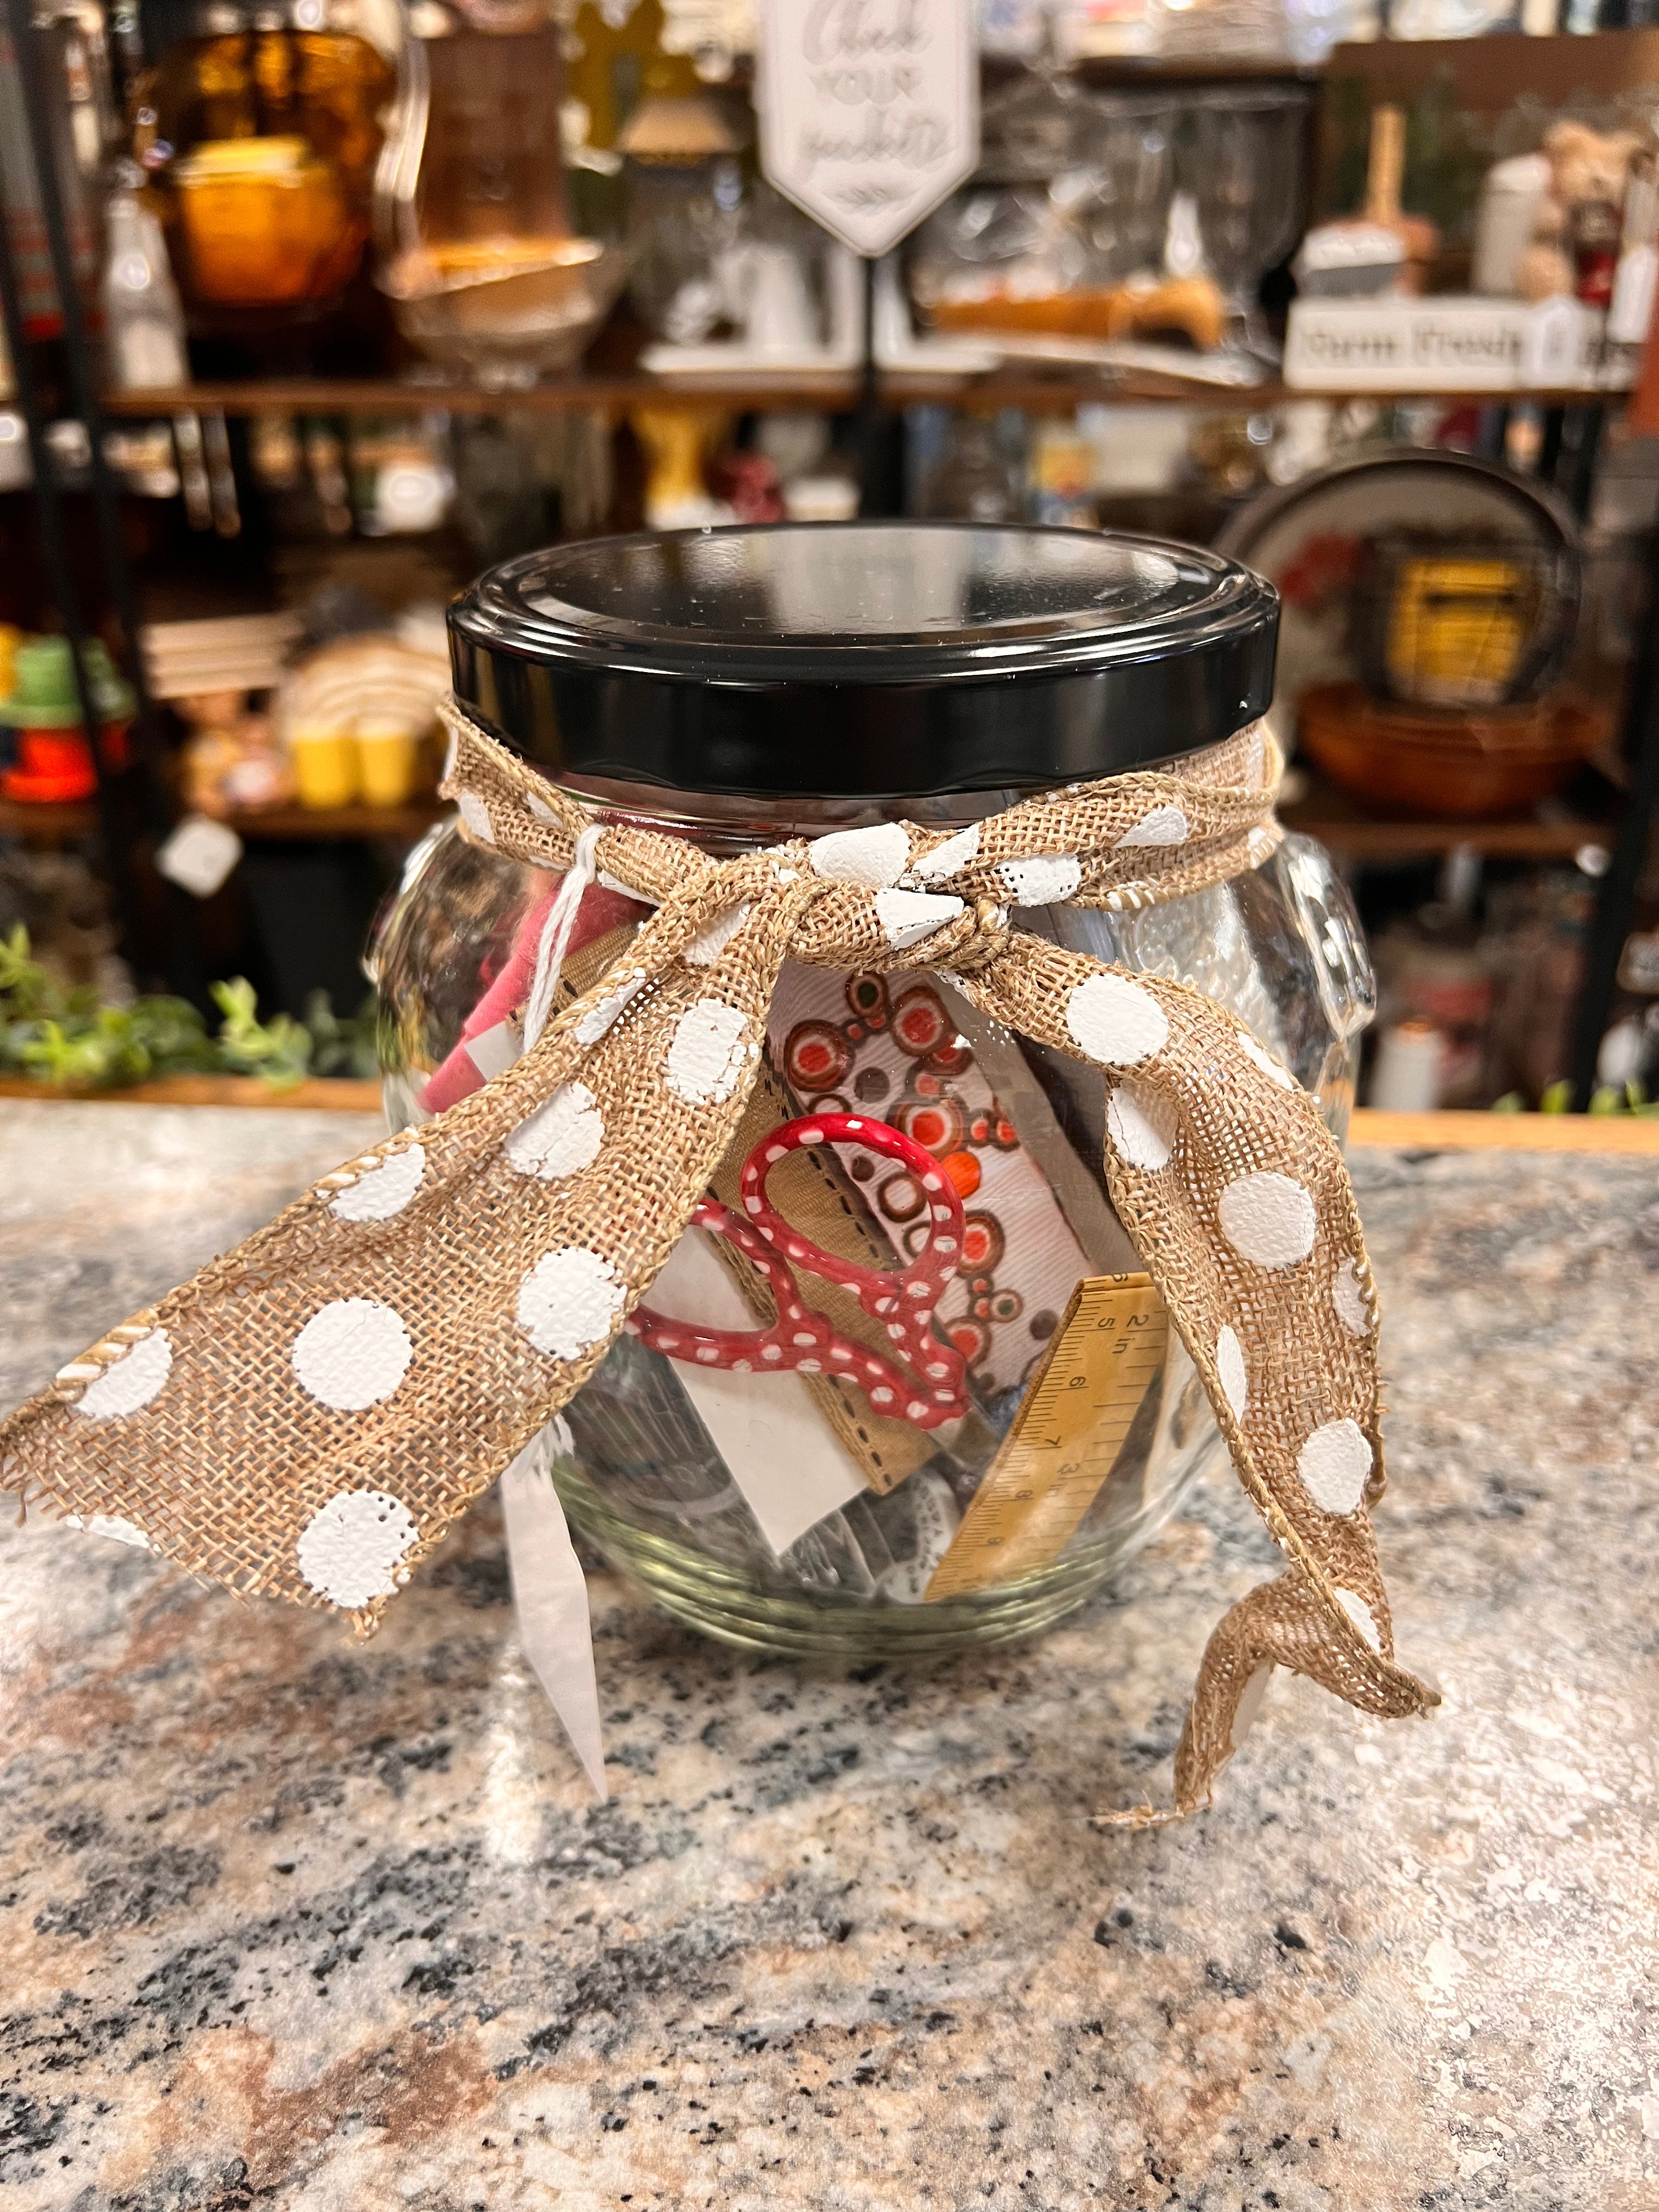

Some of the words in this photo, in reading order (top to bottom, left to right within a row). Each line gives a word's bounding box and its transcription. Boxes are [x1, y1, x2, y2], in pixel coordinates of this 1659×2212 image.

[1098, 1318, 1115, 1328] 5
[1126, 1314, 1149, 1328] 2
[1069, 1376, 1086, 1387] 6
[1045, 1435, 1062, 1446] 7
